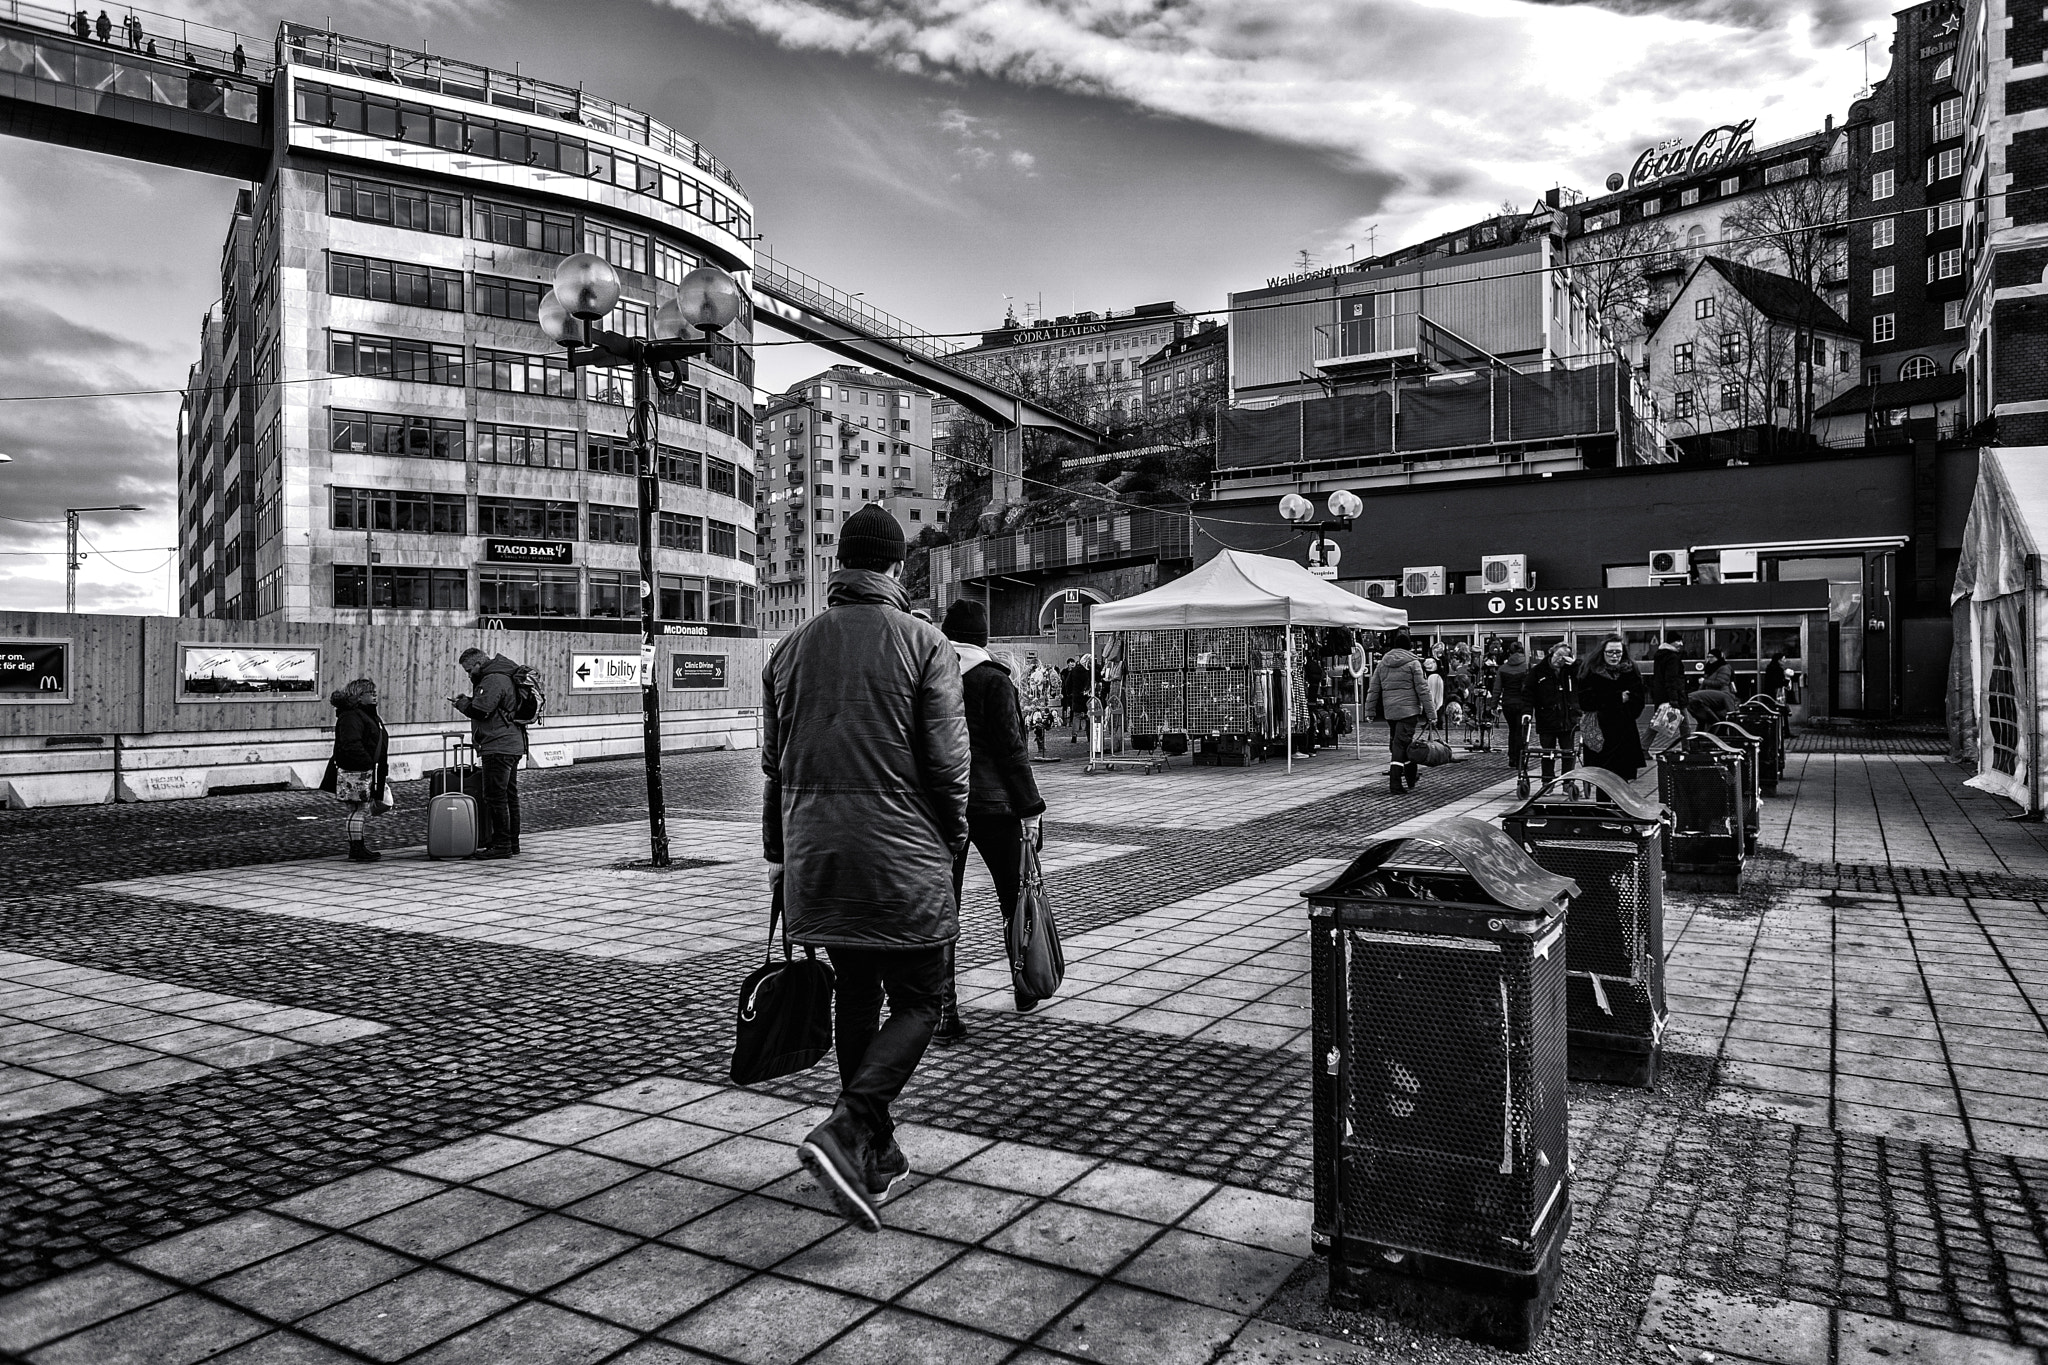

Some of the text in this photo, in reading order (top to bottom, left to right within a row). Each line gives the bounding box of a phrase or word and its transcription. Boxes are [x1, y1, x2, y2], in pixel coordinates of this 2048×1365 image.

[1628, 117, 1757, 192] Coca-Cola
[1012, 324, 1107, 345] SÖDRA TEATERN
[494, 544, 556, 556] TACO BAR
[1514, 595, 1599, 612] SLUSSEN
[663, 625, 709, 636] McDonald's
[3, 662, 35, 671] för dig!
[684, 661, 699, 669] Clinic
